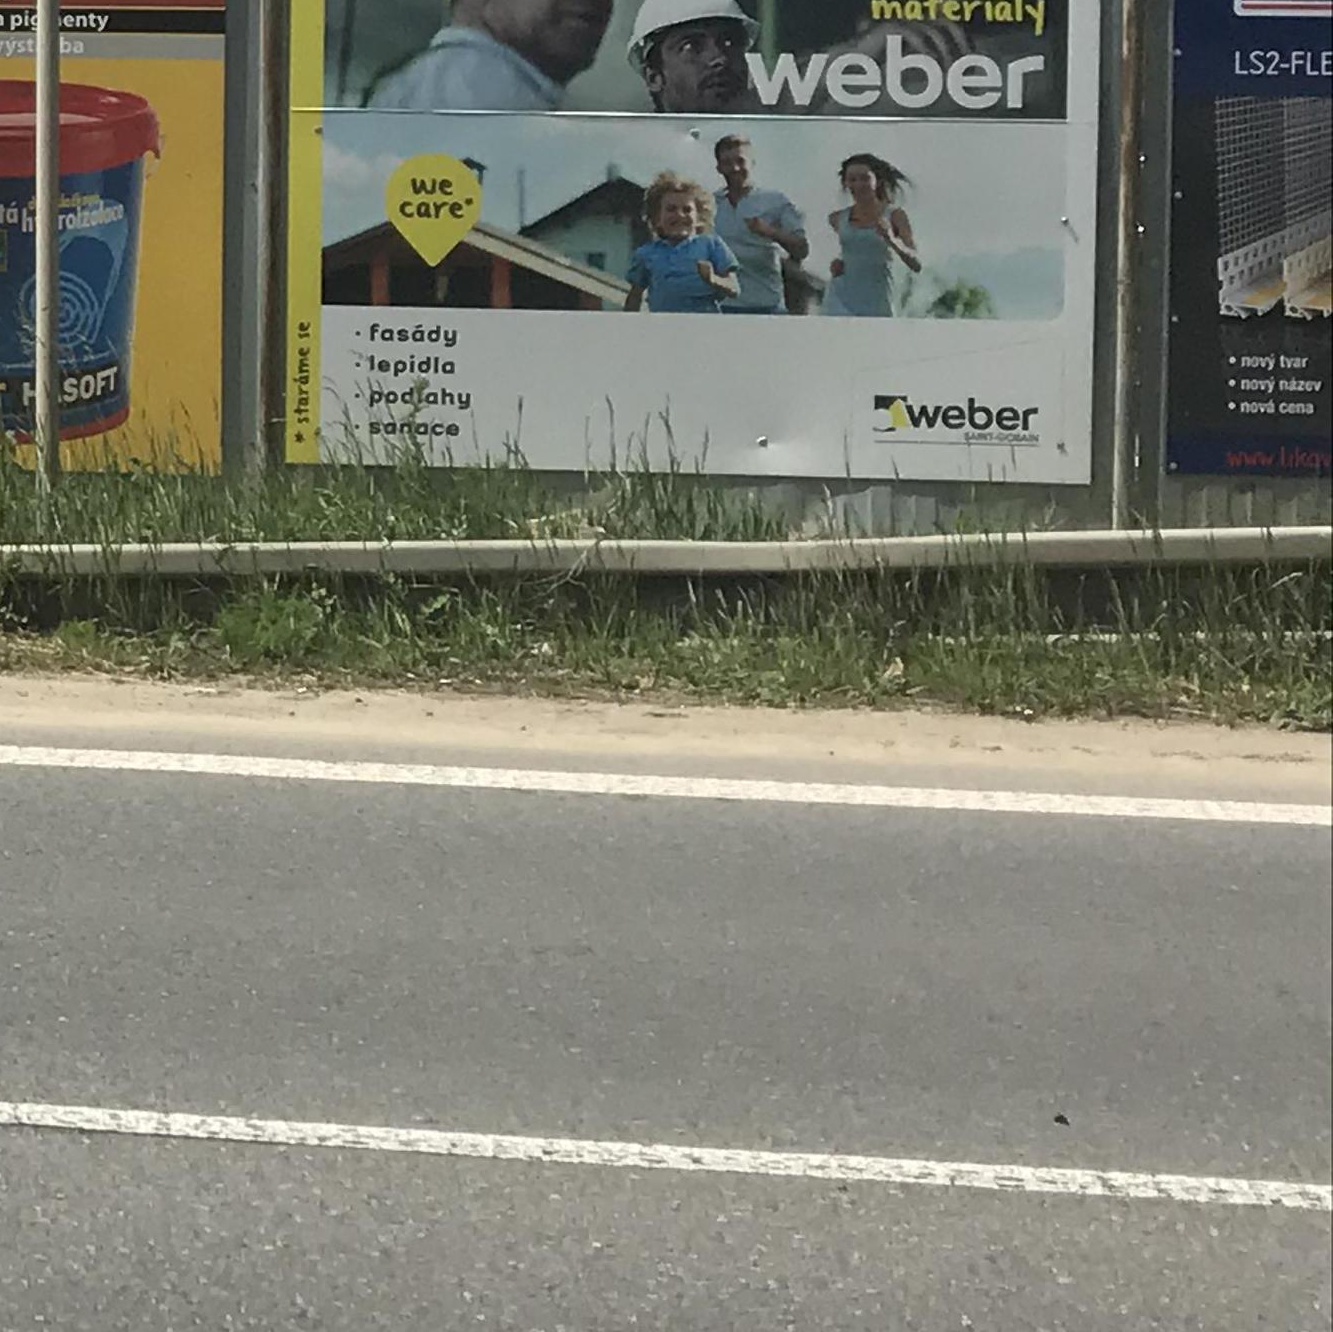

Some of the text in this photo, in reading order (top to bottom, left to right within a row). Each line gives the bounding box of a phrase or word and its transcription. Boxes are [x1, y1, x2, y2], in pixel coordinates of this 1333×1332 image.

[9, 11, 110, 33] pigenty
[744, 34, 1046, 110] weber
[410, 177, 454, 196] we
[369, 322, 458, 348] fasády
[369, 354, 456, 377] lepidla
[1241, 353, 1276, 371] nový
[21, 366, 119, 408] HSOFT
[1240, 376, 1323, 393] nový název
[906, 397, 1039, 432] weber
[1240, 399, 1315, 415] nová cena
